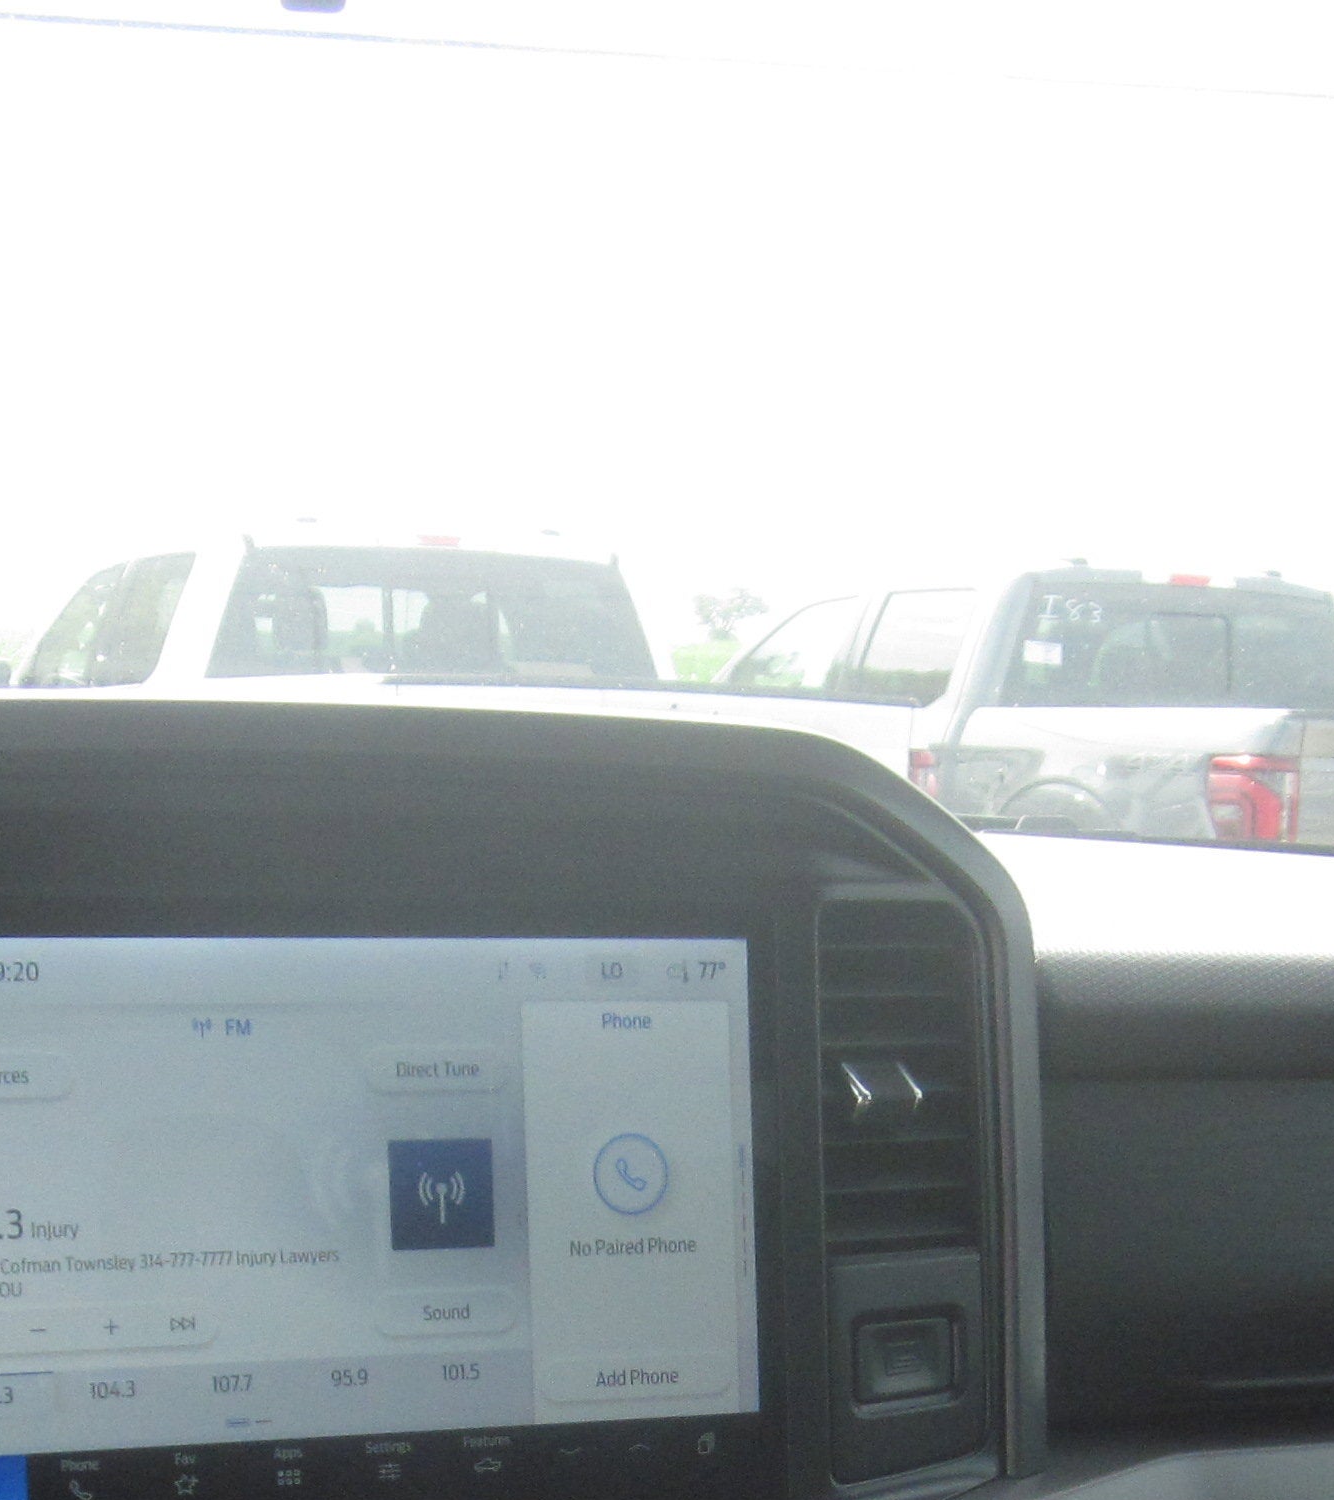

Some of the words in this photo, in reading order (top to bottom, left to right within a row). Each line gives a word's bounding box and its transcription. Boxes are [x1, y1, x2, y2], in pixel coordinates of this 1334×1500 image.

[601, 962, 623, 979] LO
[698, 961, 726, 980] 77°
[225, 1019, 251, 1036] FM
[601, 1012, 651, 1030] Phone
[396, 1061, 438, 1078] Direct
[442, 1060, 480, 1077] Tune
[31, 1221, 79, 1242] Injury
[570, 1240, 591, 1257] No
[594, 1238, 644, 1256] Paired
[648, 1236, 697, 1254] Phone
[0, 1257, 62, 1274] Cofman
[65, 1255, 135, 1274] Townsley
[139, 1251, 232, 1268] 314-777-7777
[235, 1250, 276, 1267] Injury
[279, 1248, 339, 1266] Lawyers
[423, 1303, 470, 1321] Sound
[331, 1369, 368, 1387] 95.9
[441, 1363, 480, 1381] 101.5
[596, 1370, 627, 1388] Add
[630, 1368, 679, 1386] Phone
[89, 1380, 136, 1399] 104.3
[212, 1375, 253, 1392] 107.7
[366, 1440, 412, 1455] Settings
[463, 1435, 511, 1447] Features
[174, 1452, 196, 1465] Fav
[274, 1447, 303, 1461] Apps
[60, 1459, 100, 1472] Phone
